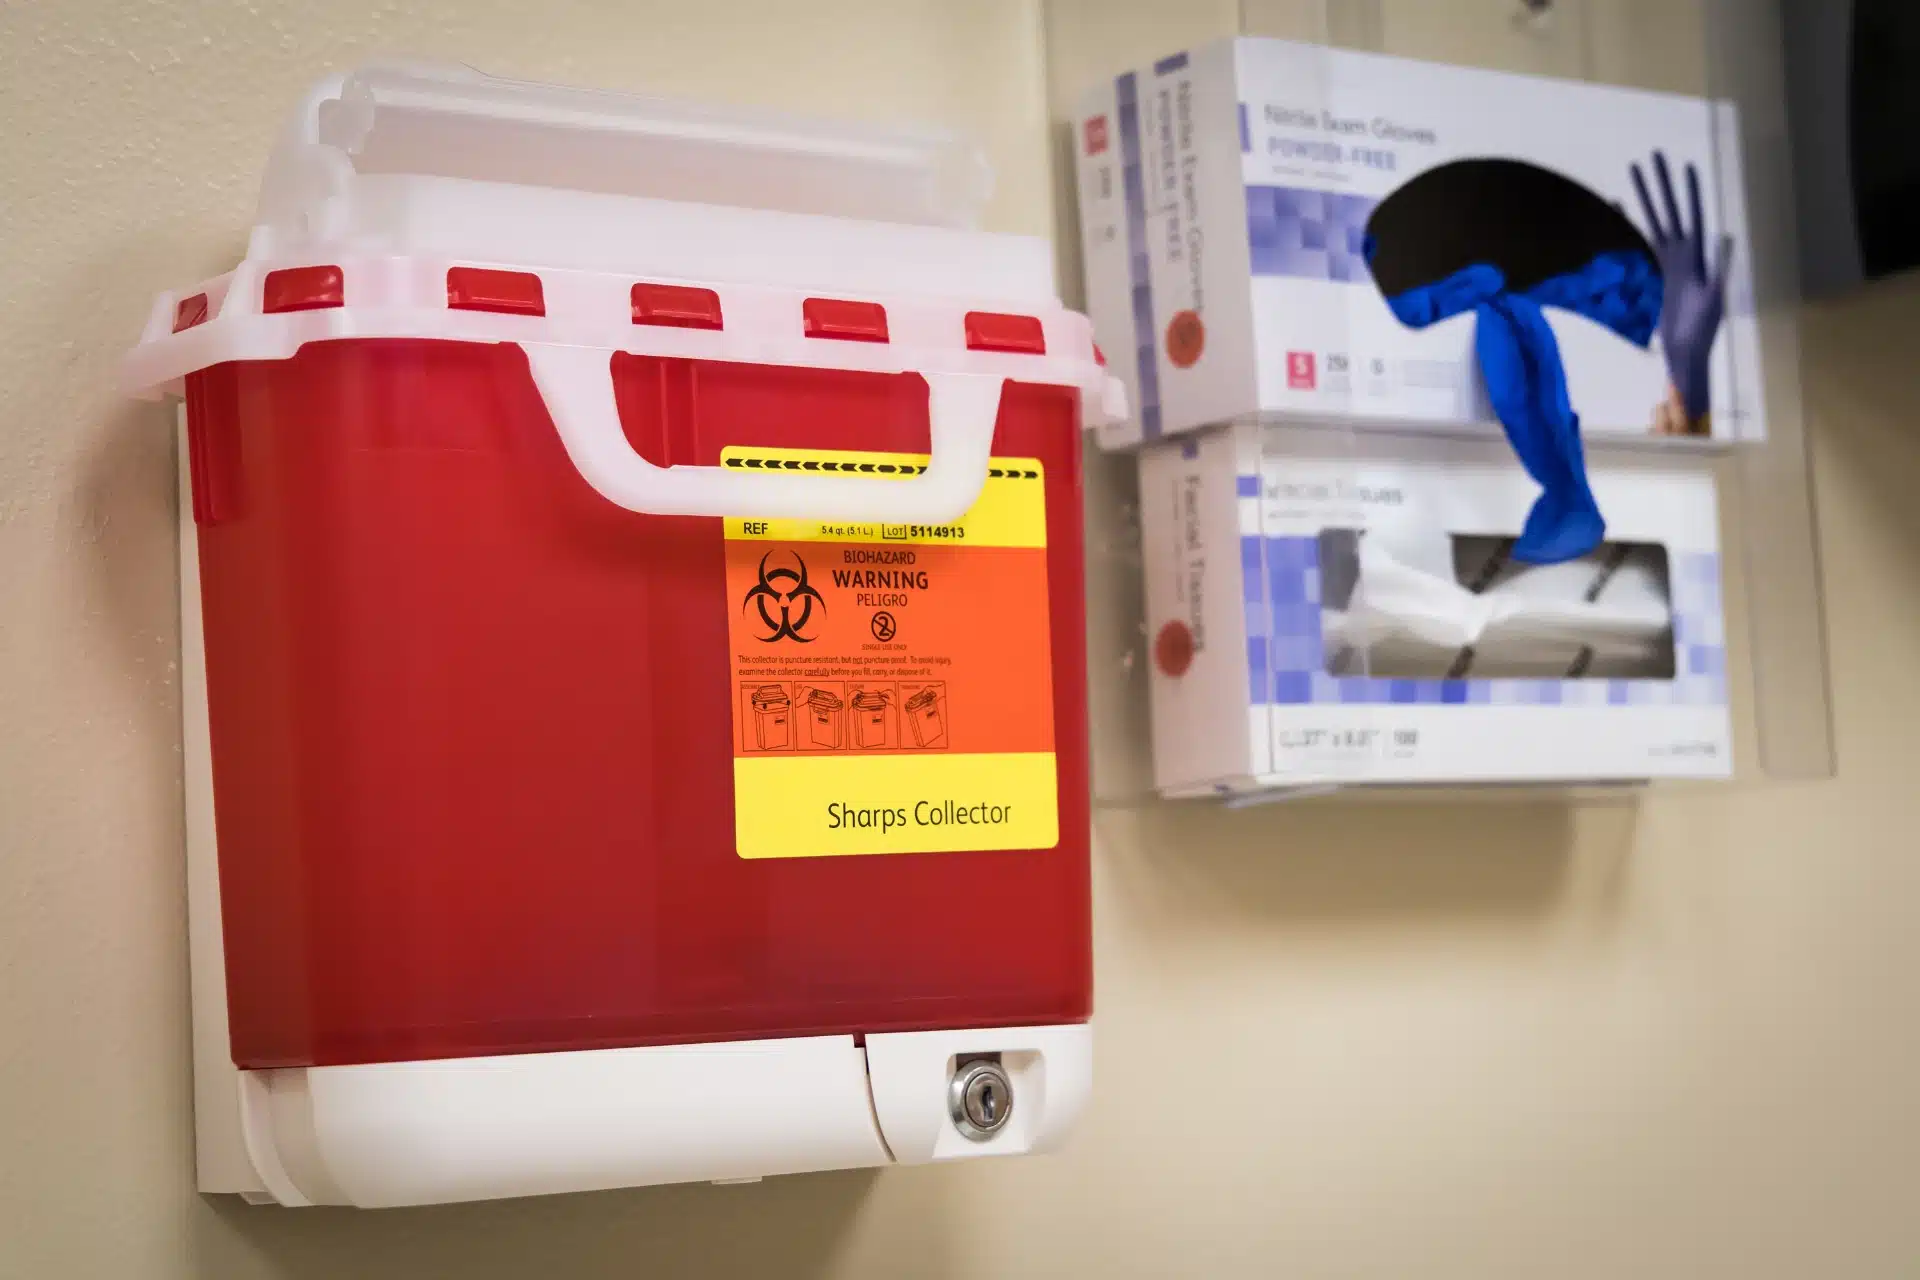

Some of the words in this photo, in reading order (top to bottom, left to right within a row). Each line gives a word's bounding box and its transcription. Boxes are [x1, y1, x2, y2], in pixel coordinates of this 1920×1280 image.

[743, 522, 769, 535] REF
[821, 526, 834, 535] 5.4
[835, 526, 846, 537] qt.
[847, 526, 862, 537] (5.1
[887, 527, 903, 537] LOT
[910, 525, 965, 538] 5114913
[843, 550, 916, 565] BIOHAZARD
[832, 569, 929, 590] WARNING
[856, 593, 908, 607] PELIGRO
[861, 643, 881, 651] SINGLE
[738, 654, 751, 664] This
[752, 655, 777, 664] collector
[785, 656, 812, 666] puncture
[841, 656, 852, 664] but
[852, 656, 864, 665] not
[864, 656, 890, 666] puncture
[910, 656, 918, 664] To
[918, 656, 934, 665] avoid
[739, 668, 765, 676] examine
[766, 667, 776, 676] the
[777, 667, 803, 676] collector
[804, 667, 830, 678] carefully
[831, 667, 850, 676] before
[851, 669, 862, 678] you
[897, 667, 918, 678] dispose
[828, 802, 907, 834] Sharps
[914, 800, 1011, 826] Collector
